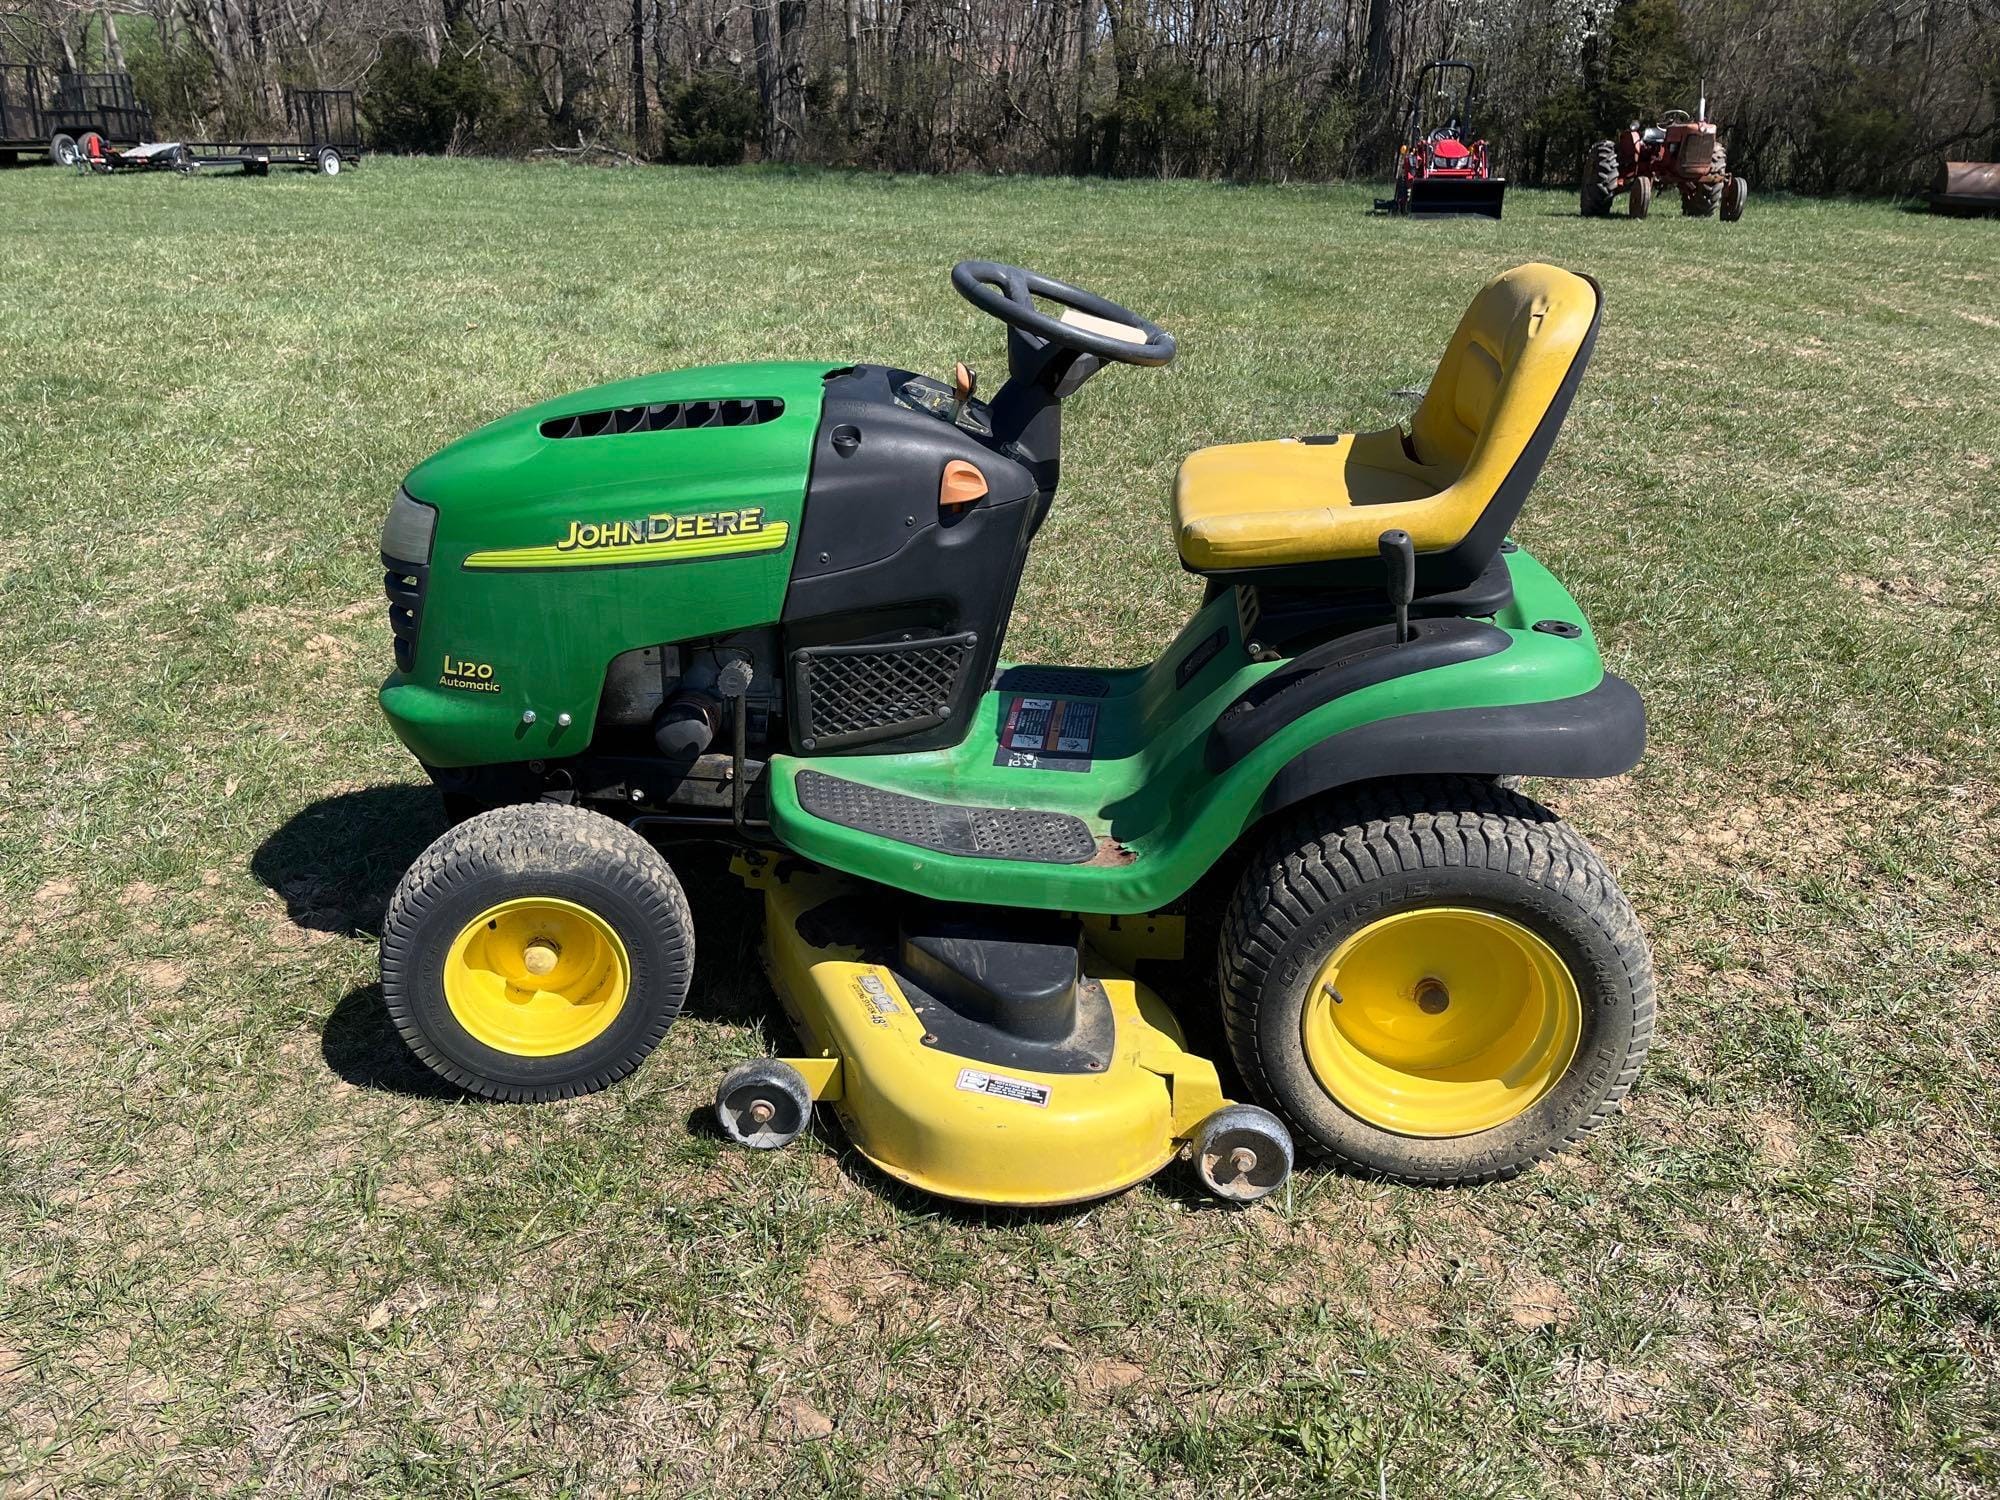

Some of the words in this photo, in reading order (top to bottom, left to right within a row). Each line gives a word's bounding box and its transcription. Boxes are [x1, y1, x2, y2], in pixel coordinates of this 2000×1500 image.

[439, 675, 501, 692] Automatic
[444, 654, 494, 679] L120
[1279, 879, 1433, 988] CARLISLE
[1555, 1047, 1618, 1124] TURF
